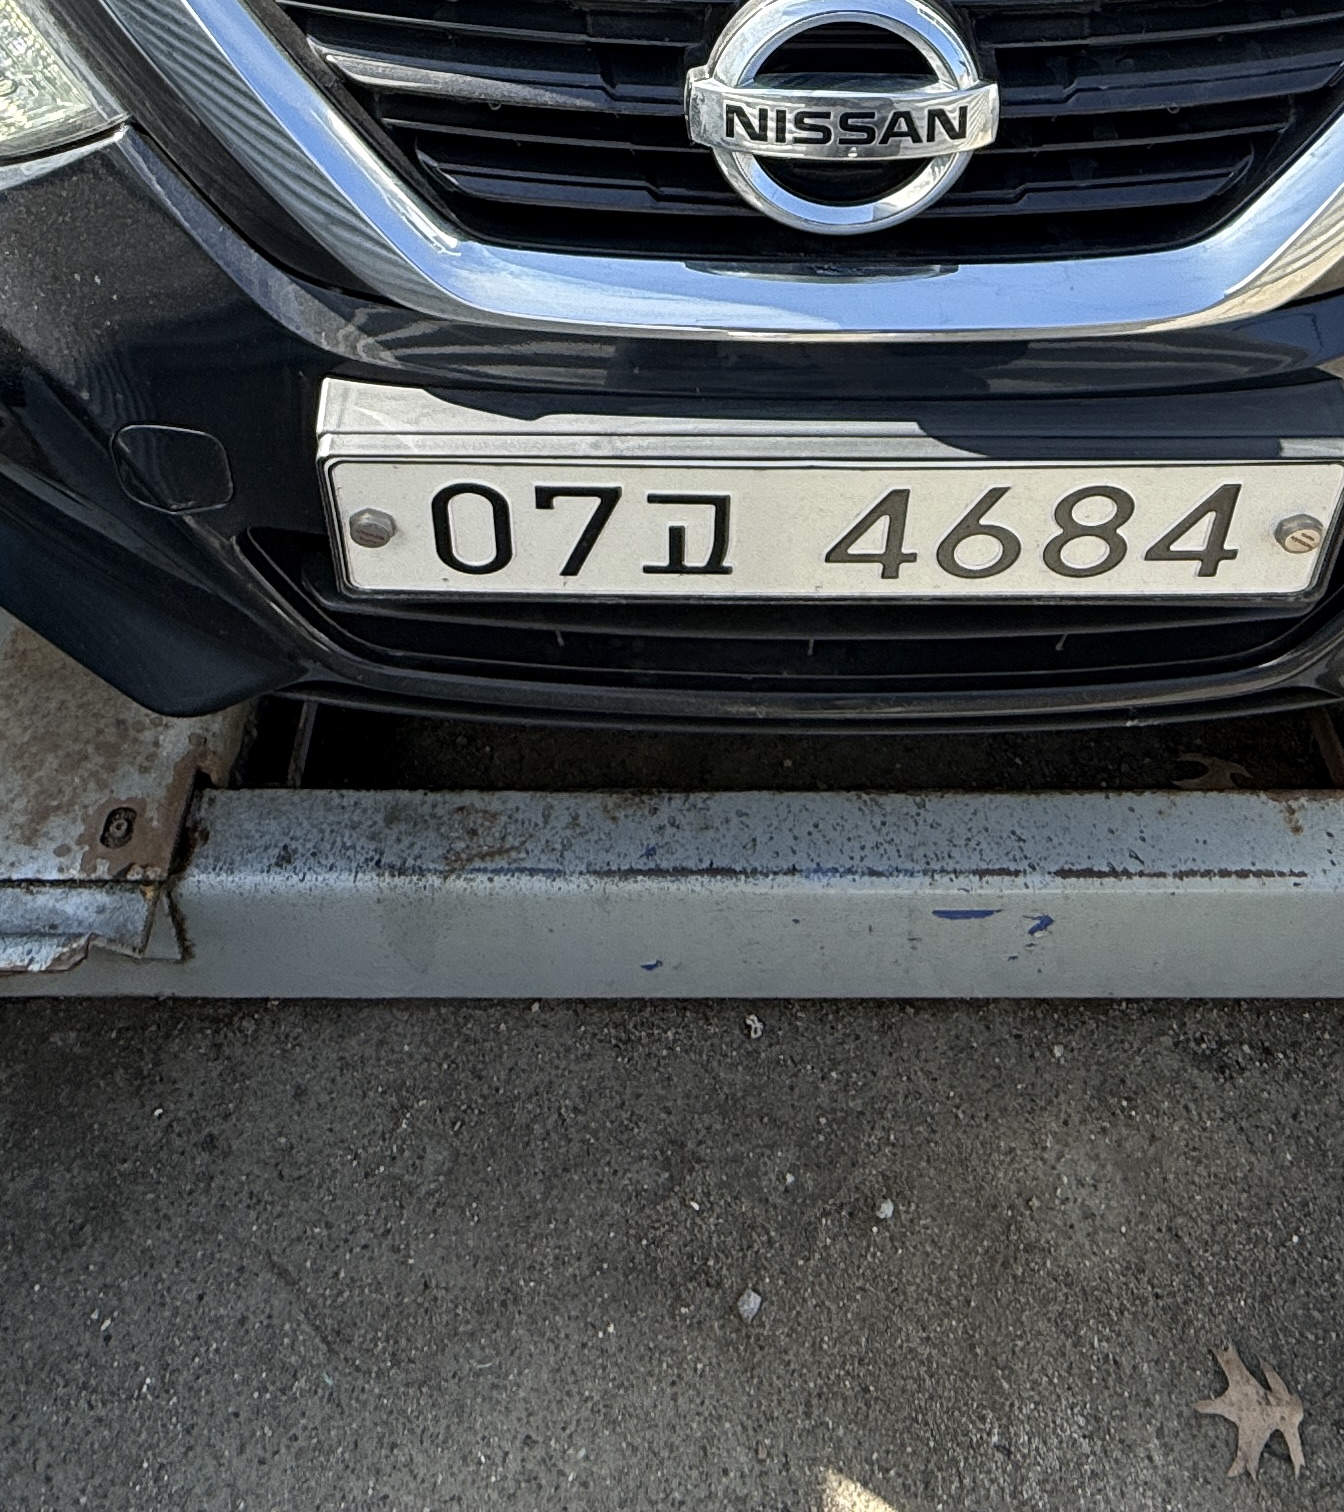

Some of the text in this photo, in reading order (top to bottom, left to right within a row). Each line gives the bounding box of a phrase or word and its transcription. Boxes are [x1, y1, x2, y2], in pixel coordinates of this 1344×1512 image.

[725, 103, 968, 145] NISSAN
[431, 482, 1242, 579] 07고 4684
